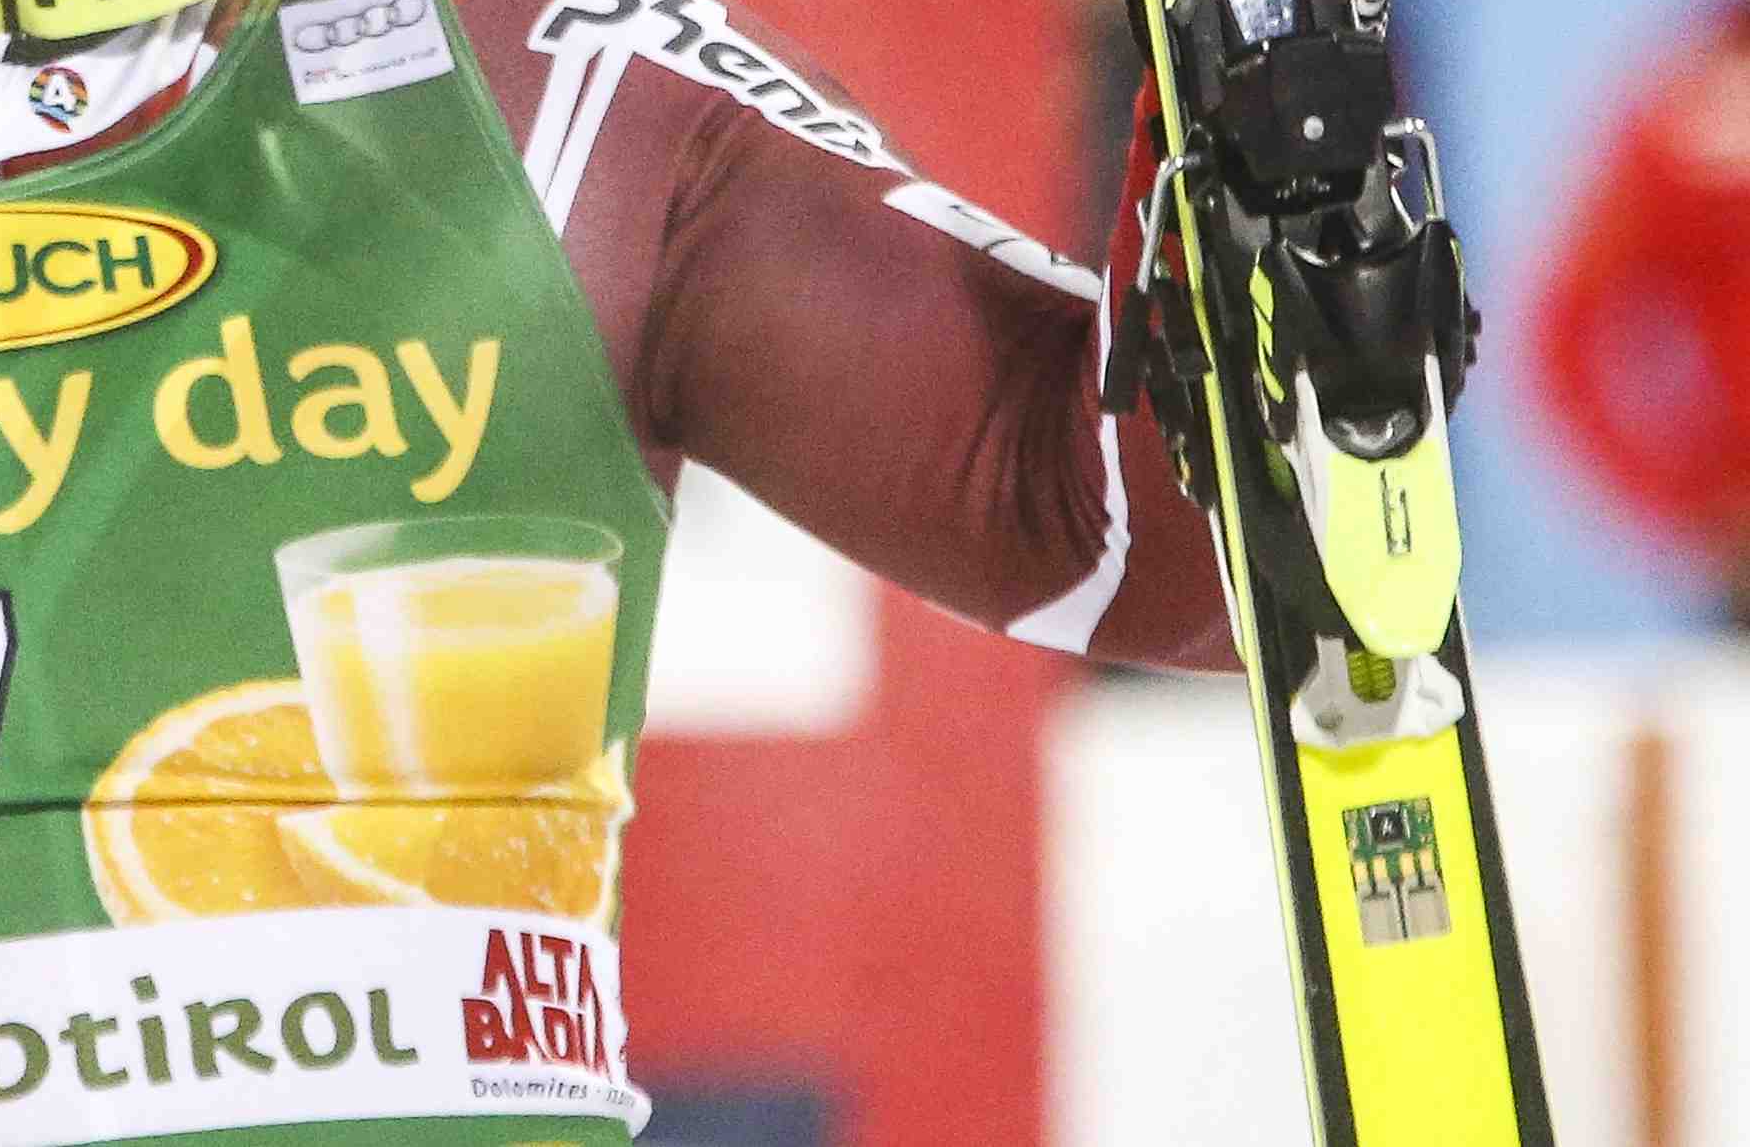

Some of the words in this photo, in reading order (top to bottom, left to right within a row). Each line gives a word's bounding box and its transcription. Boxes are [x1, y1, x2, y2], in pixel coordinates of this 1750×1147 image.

[153, 315, 502, 503] day
[481, 928, 602, 1003] ALTA
[461, 997, 610, 1075] BADIA
[471, 1076, 588, 1100] Dolomites
